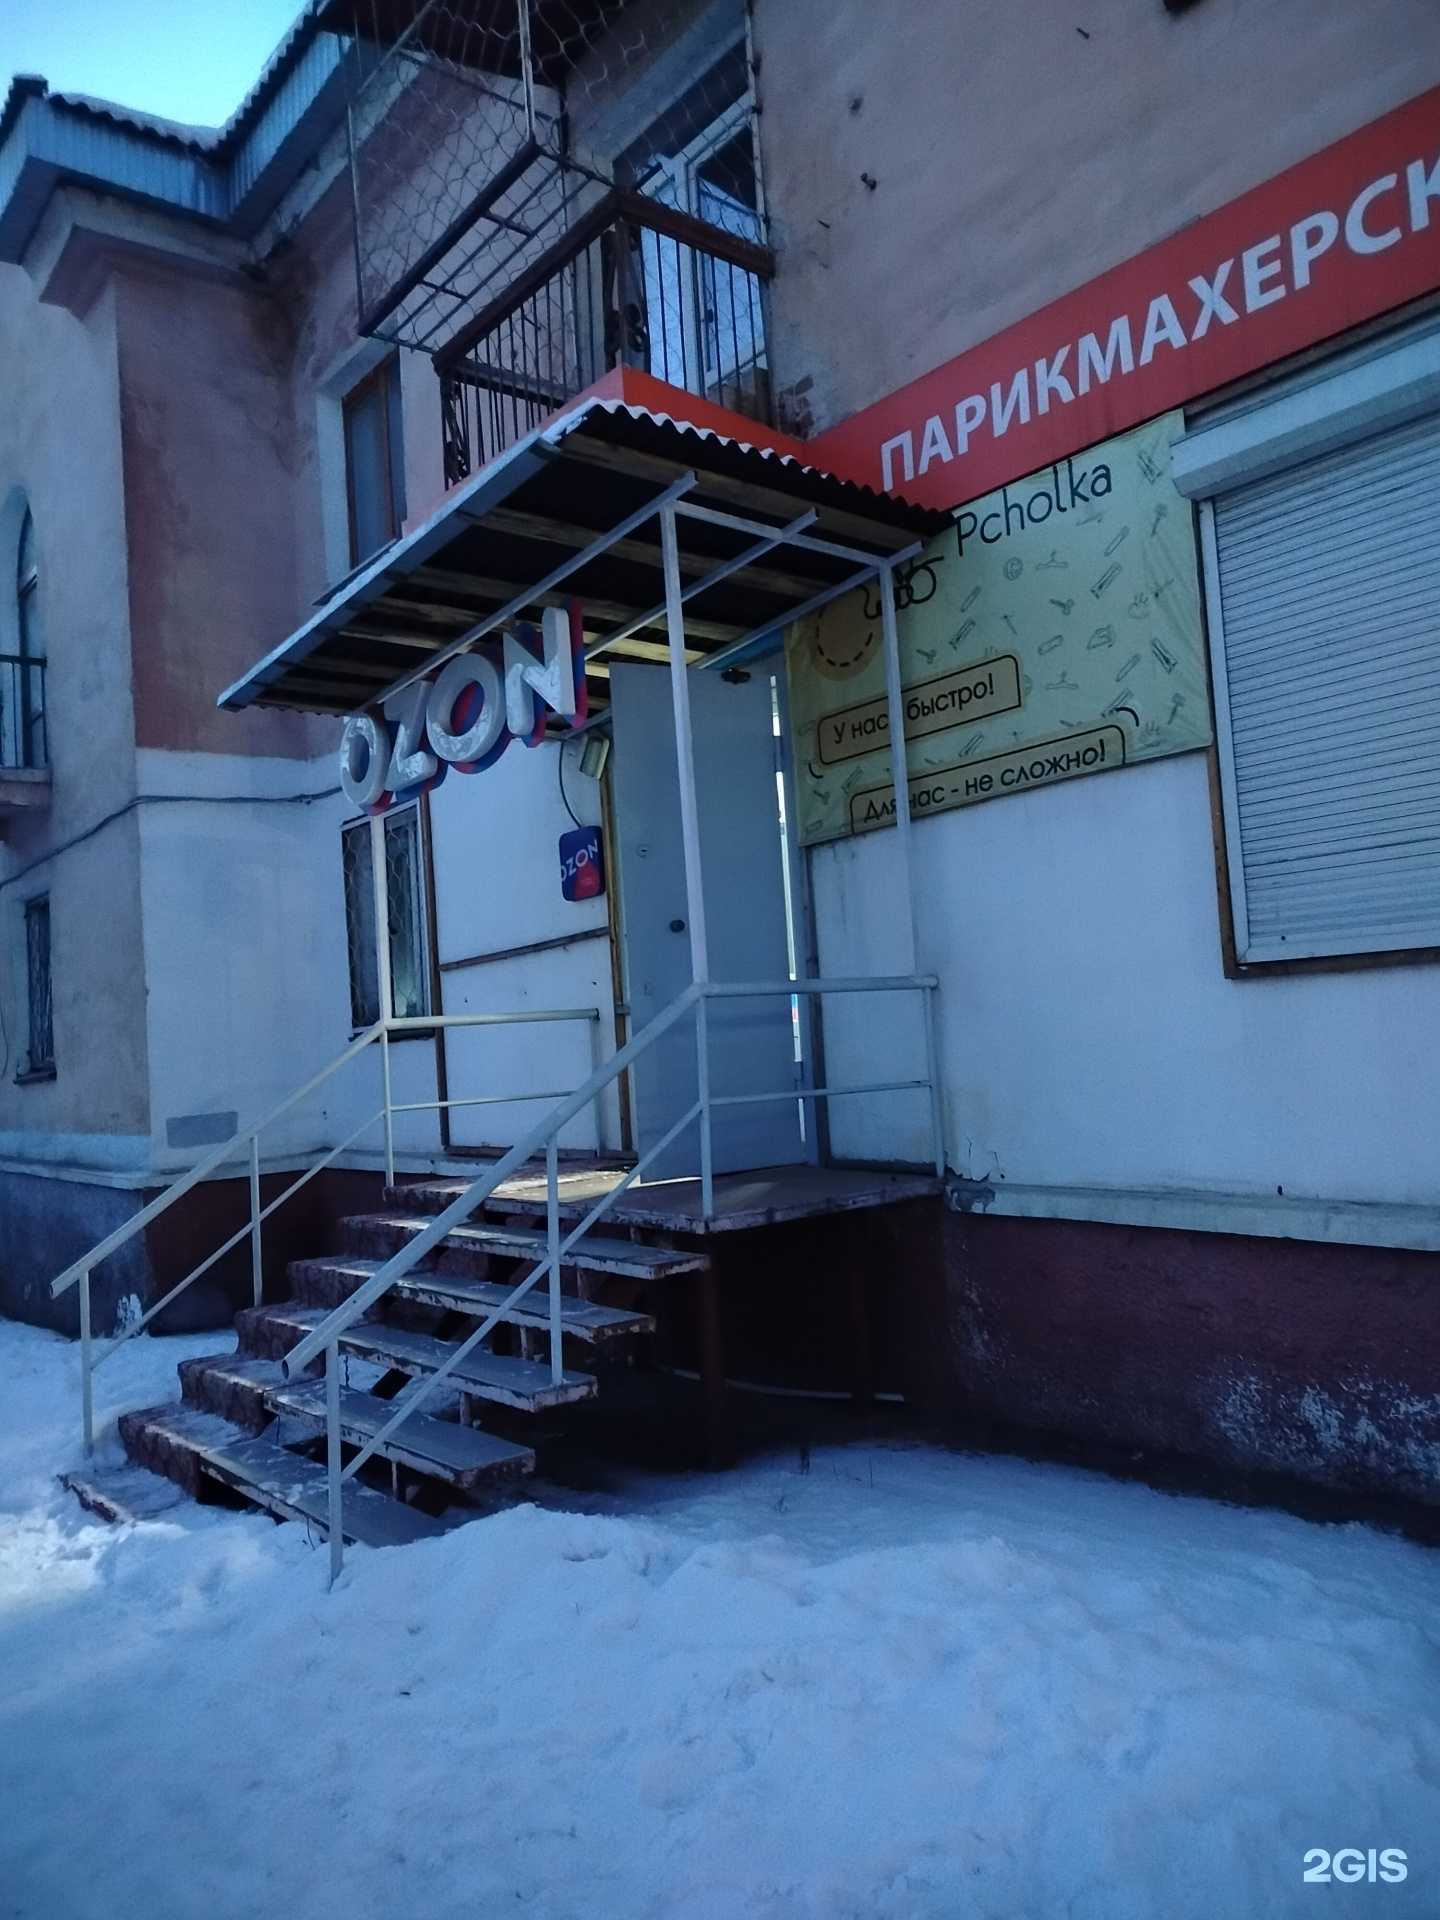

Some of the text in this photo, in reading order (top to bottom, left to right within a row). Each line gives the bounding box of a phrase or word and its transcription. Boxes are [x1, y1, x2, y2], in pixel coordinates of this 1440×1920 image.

[880, 155, 1440, 492] ПАРИКМАХЕРСК
[954, 458, 1113, 557] Pcholka
[340, 598, 588, 816] OZON
[850, 713, 890, 739] нас
[906, 673, 995, 721] быстро!
[965, 774, 993, 797] не
[1000, 738, 1106, 787] сложно!
